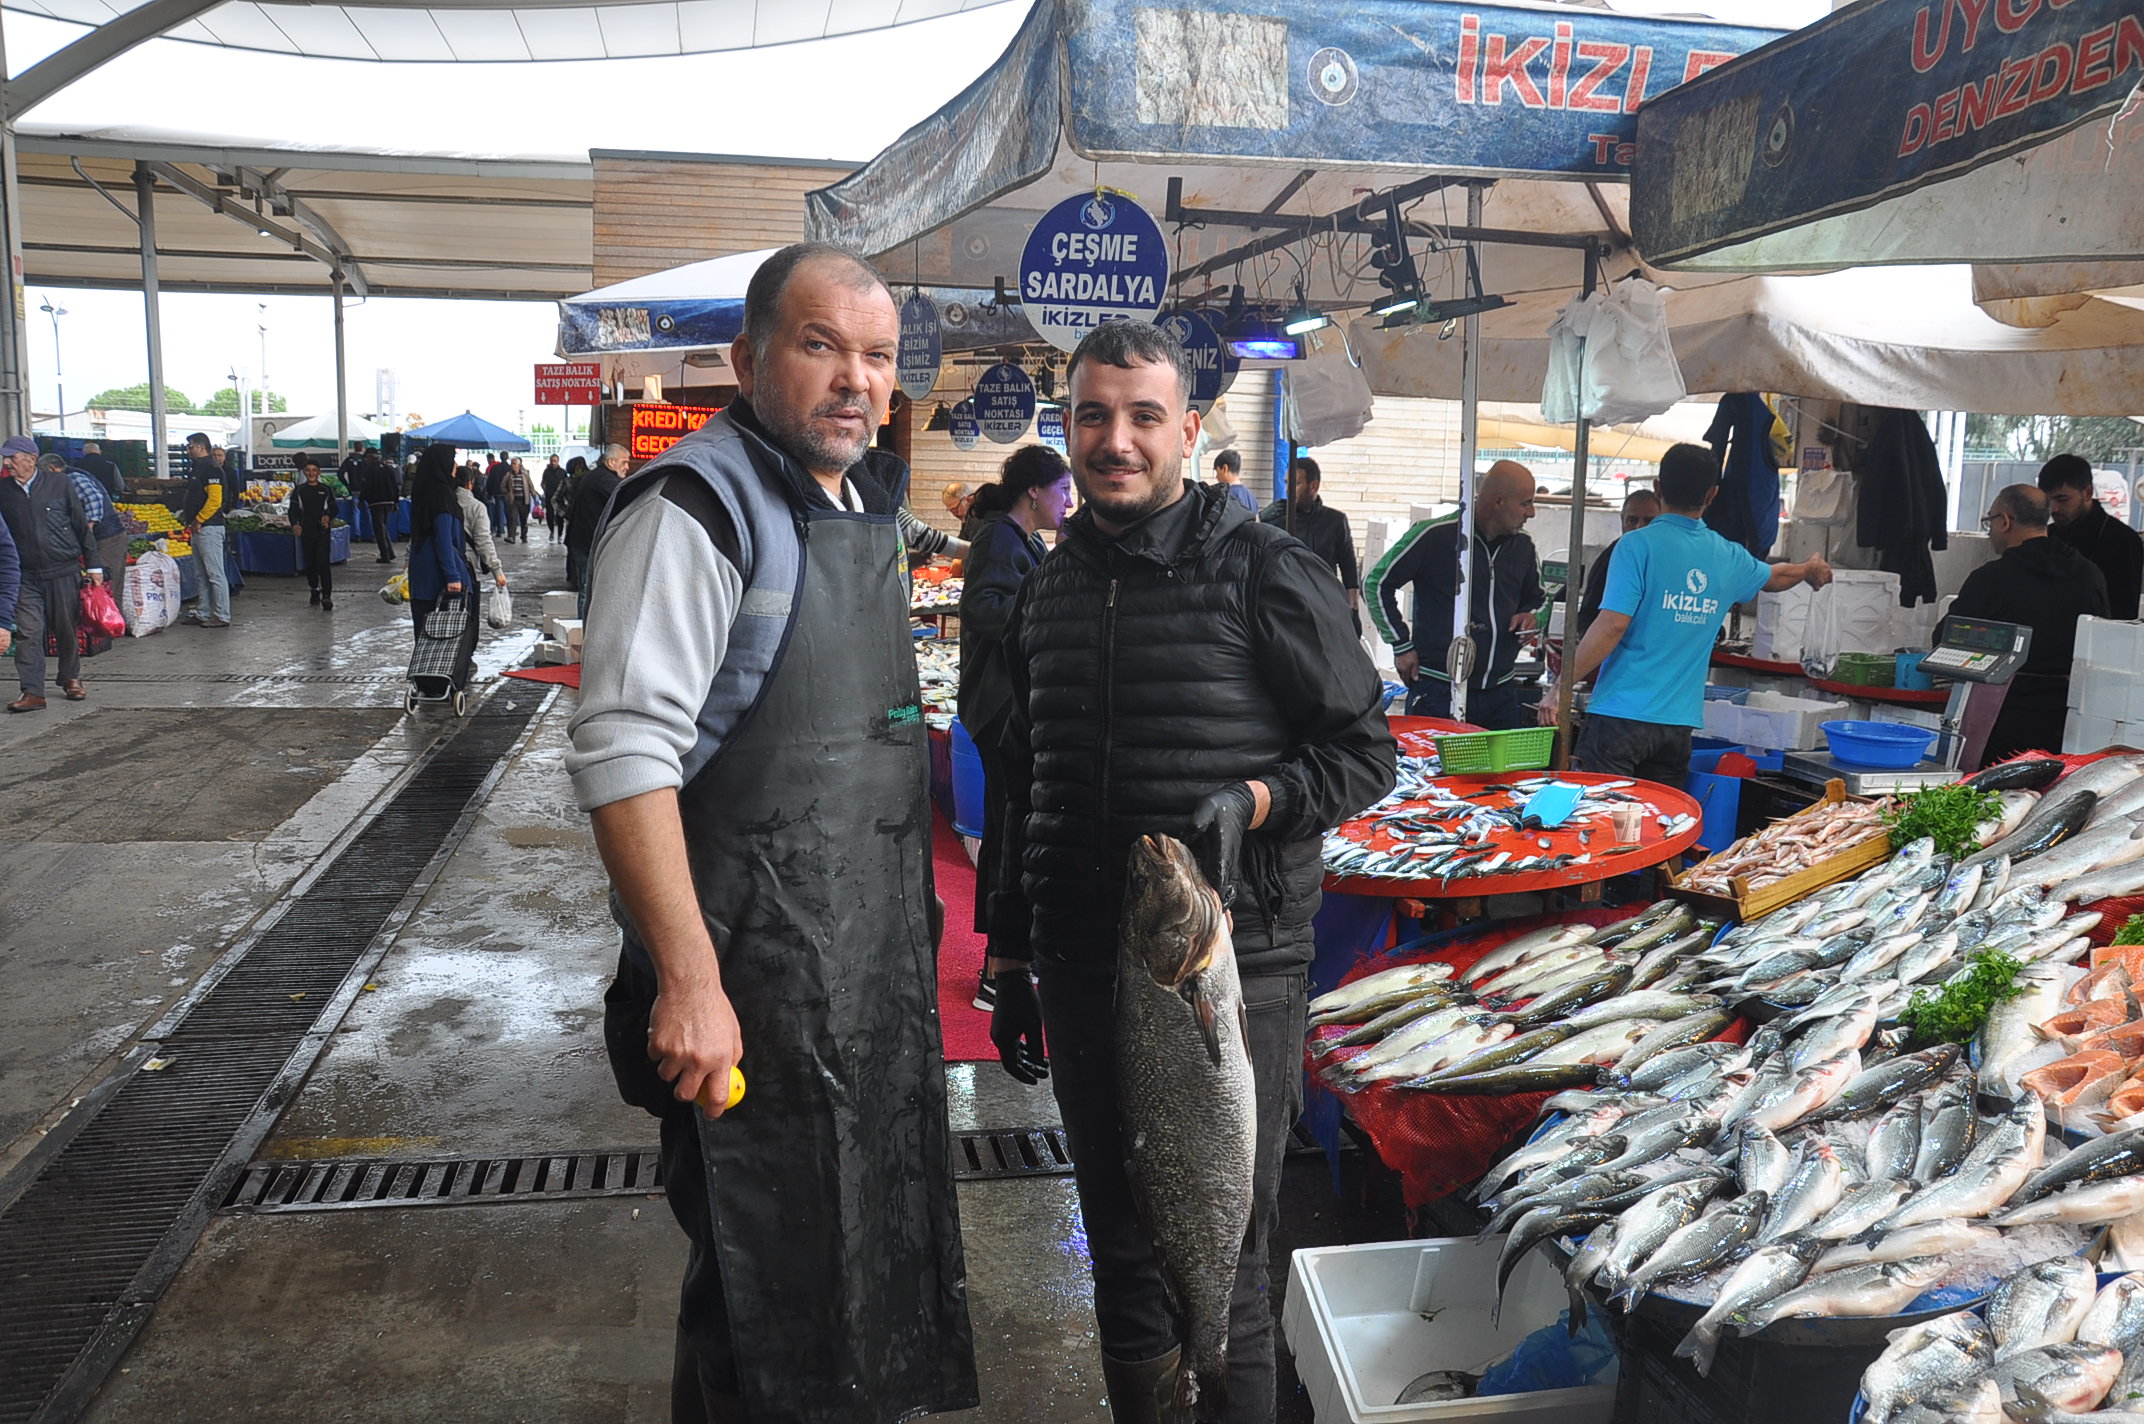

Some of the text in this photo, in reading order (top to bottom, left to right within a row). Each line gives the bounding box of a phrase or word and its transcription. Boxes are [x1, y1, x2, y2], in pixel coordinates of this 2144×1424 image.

[1052, 232, 1138, 268] ÇEŞME
[1027, 271, 1156, 303] SARDALYA
[900, 324, 922, 335] ALIK
[904, 337, 929, 350] BİZİM
[903, 351, 930, 368] İŞİMİZ
[542, 365, 593, 376] TAZE BALIK
[536, 377, 600, 389] SATIŞ NOKTASI
[979, 383, 1031, 393] TAZE BALIK
[992, 396, 1017, 408] SATIŞ
[984, 409, 1024, 419] NOKTASI
[984, 420, 1022, 431] İKİZLER
[1662, 589, 1719, 614] İKİZLER
